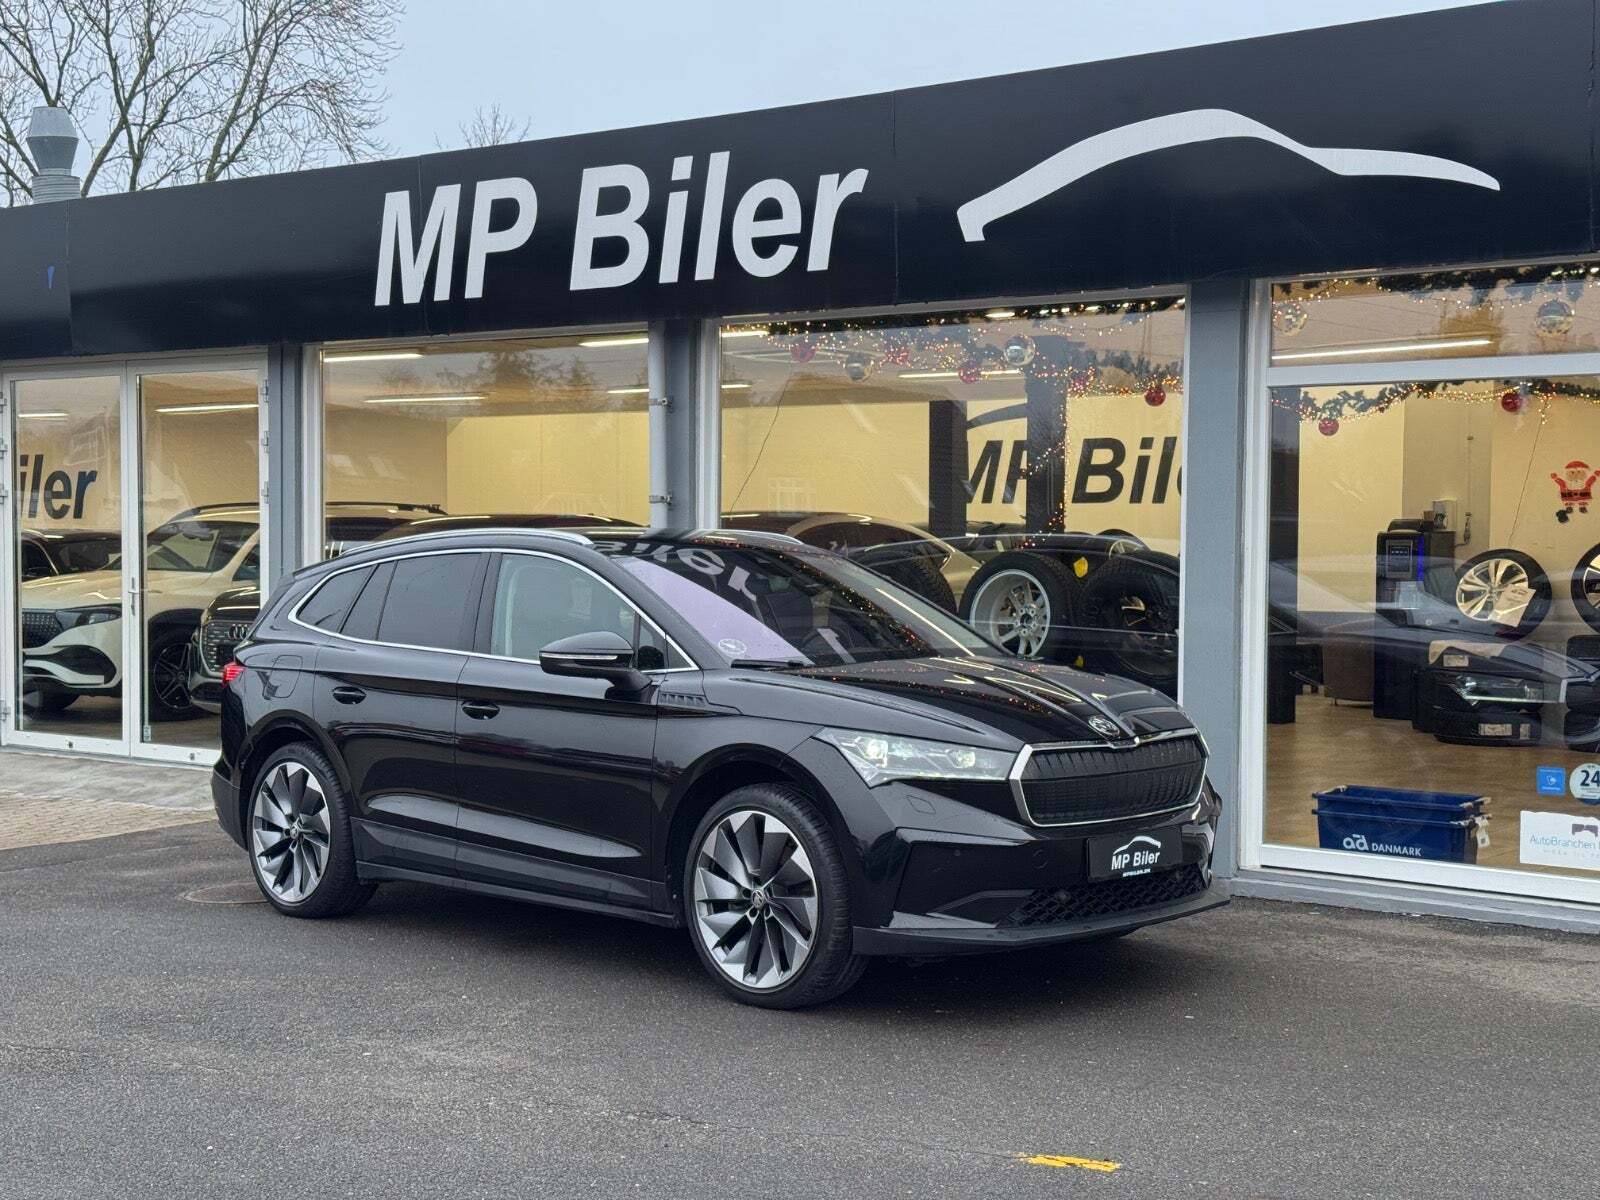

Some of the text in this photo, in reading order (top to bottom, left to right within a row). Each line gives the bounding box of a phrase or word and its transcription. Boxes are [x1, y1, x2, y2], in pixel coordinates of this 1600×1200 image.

[374, 150, 870, 307] MP Biler
[1071, 436, 1182, 504] Bil
[1371, 842, 1422, 857] DANMARK
[1529, 834, 1596, 851] AutoBranchen
[1111, 850, 1161, 870] MP Biler
